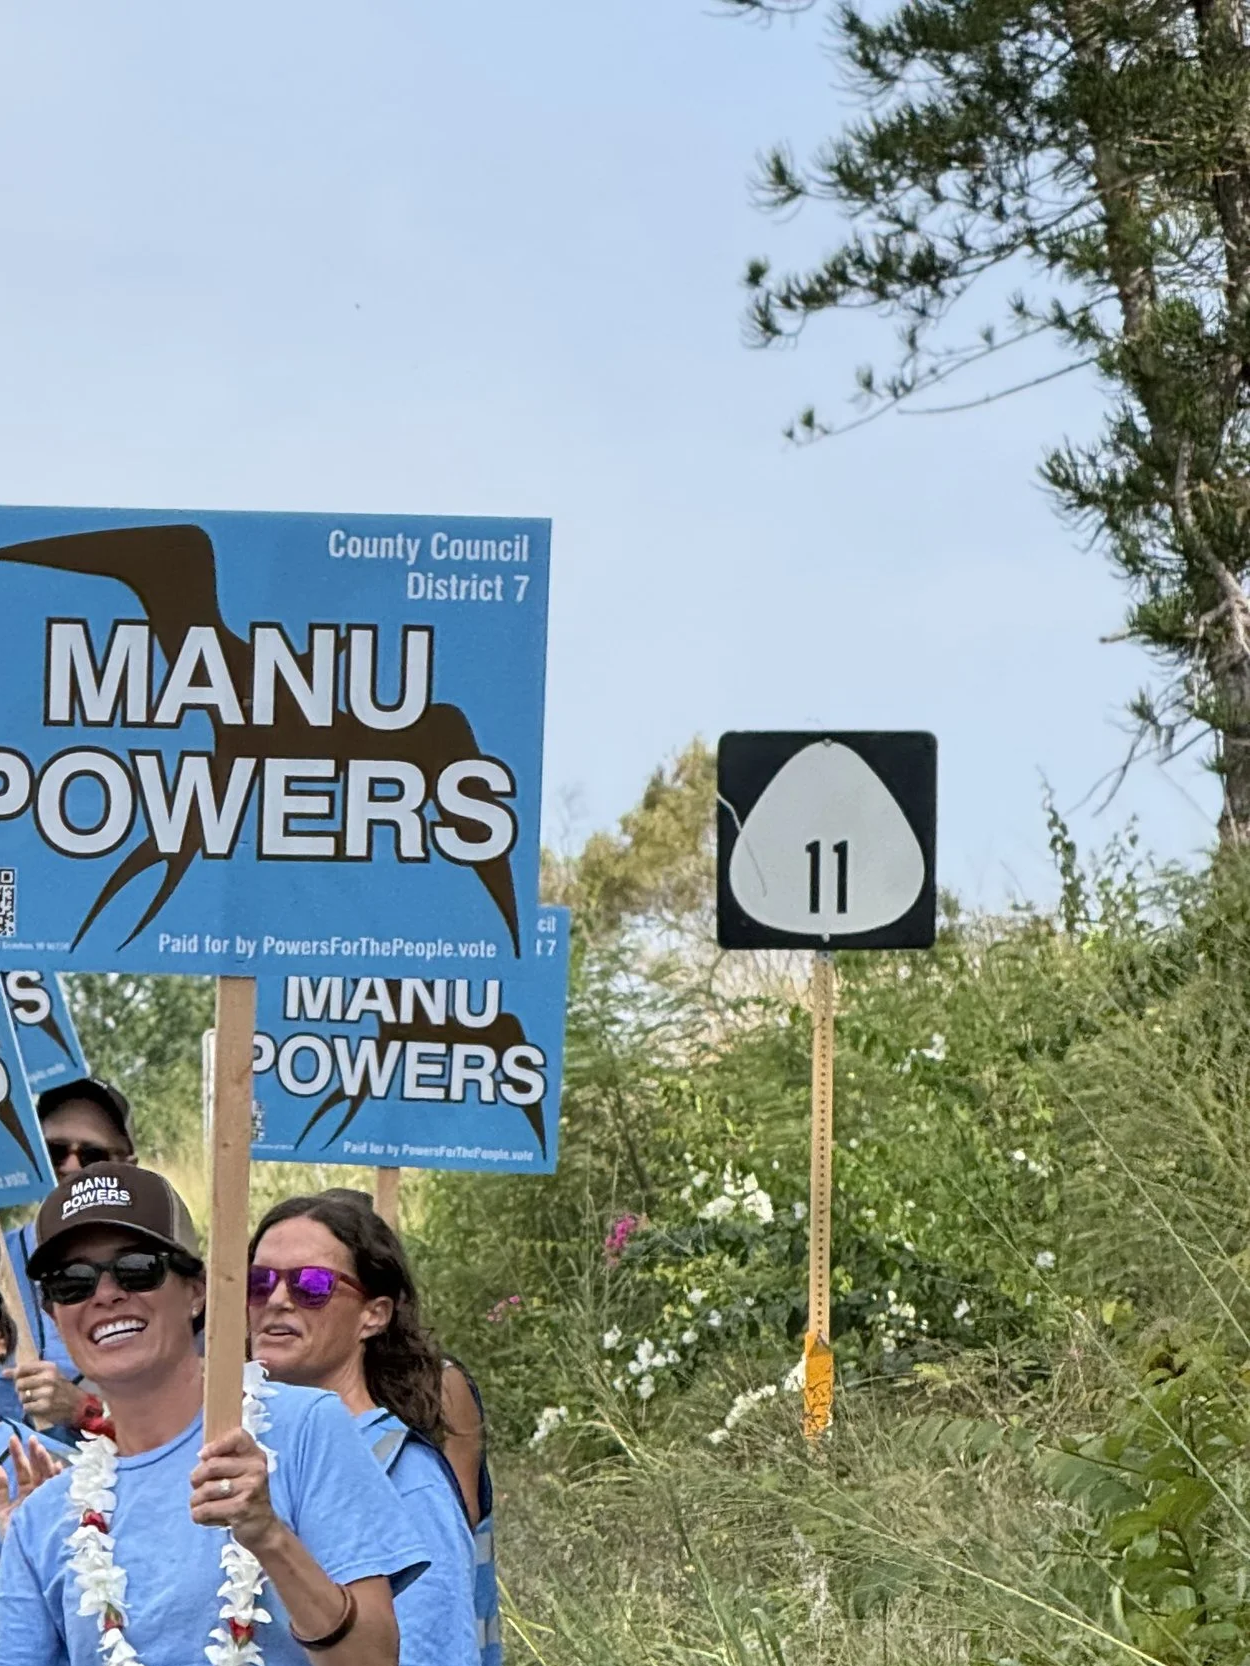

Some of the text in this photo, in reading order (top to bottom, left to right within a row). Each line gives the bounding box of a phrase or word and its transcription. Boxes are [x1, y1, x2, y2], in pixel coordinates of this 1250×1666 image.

[328, 529, 530, 566] County Council
[406, 571, 530, 603] District 7
[45, 617, 434, 732] MANU
[805, 840, 848, 914] 11
[158, 932, 497, 962] Paid for by PowersForThePeople.vote
[283, 975, 501, 1030] MANU
[342, 1140, 367, 1154] Paid
[62, 1188, 131, 1215] POWERS
[71, 1176, 118, 1197] MANU
